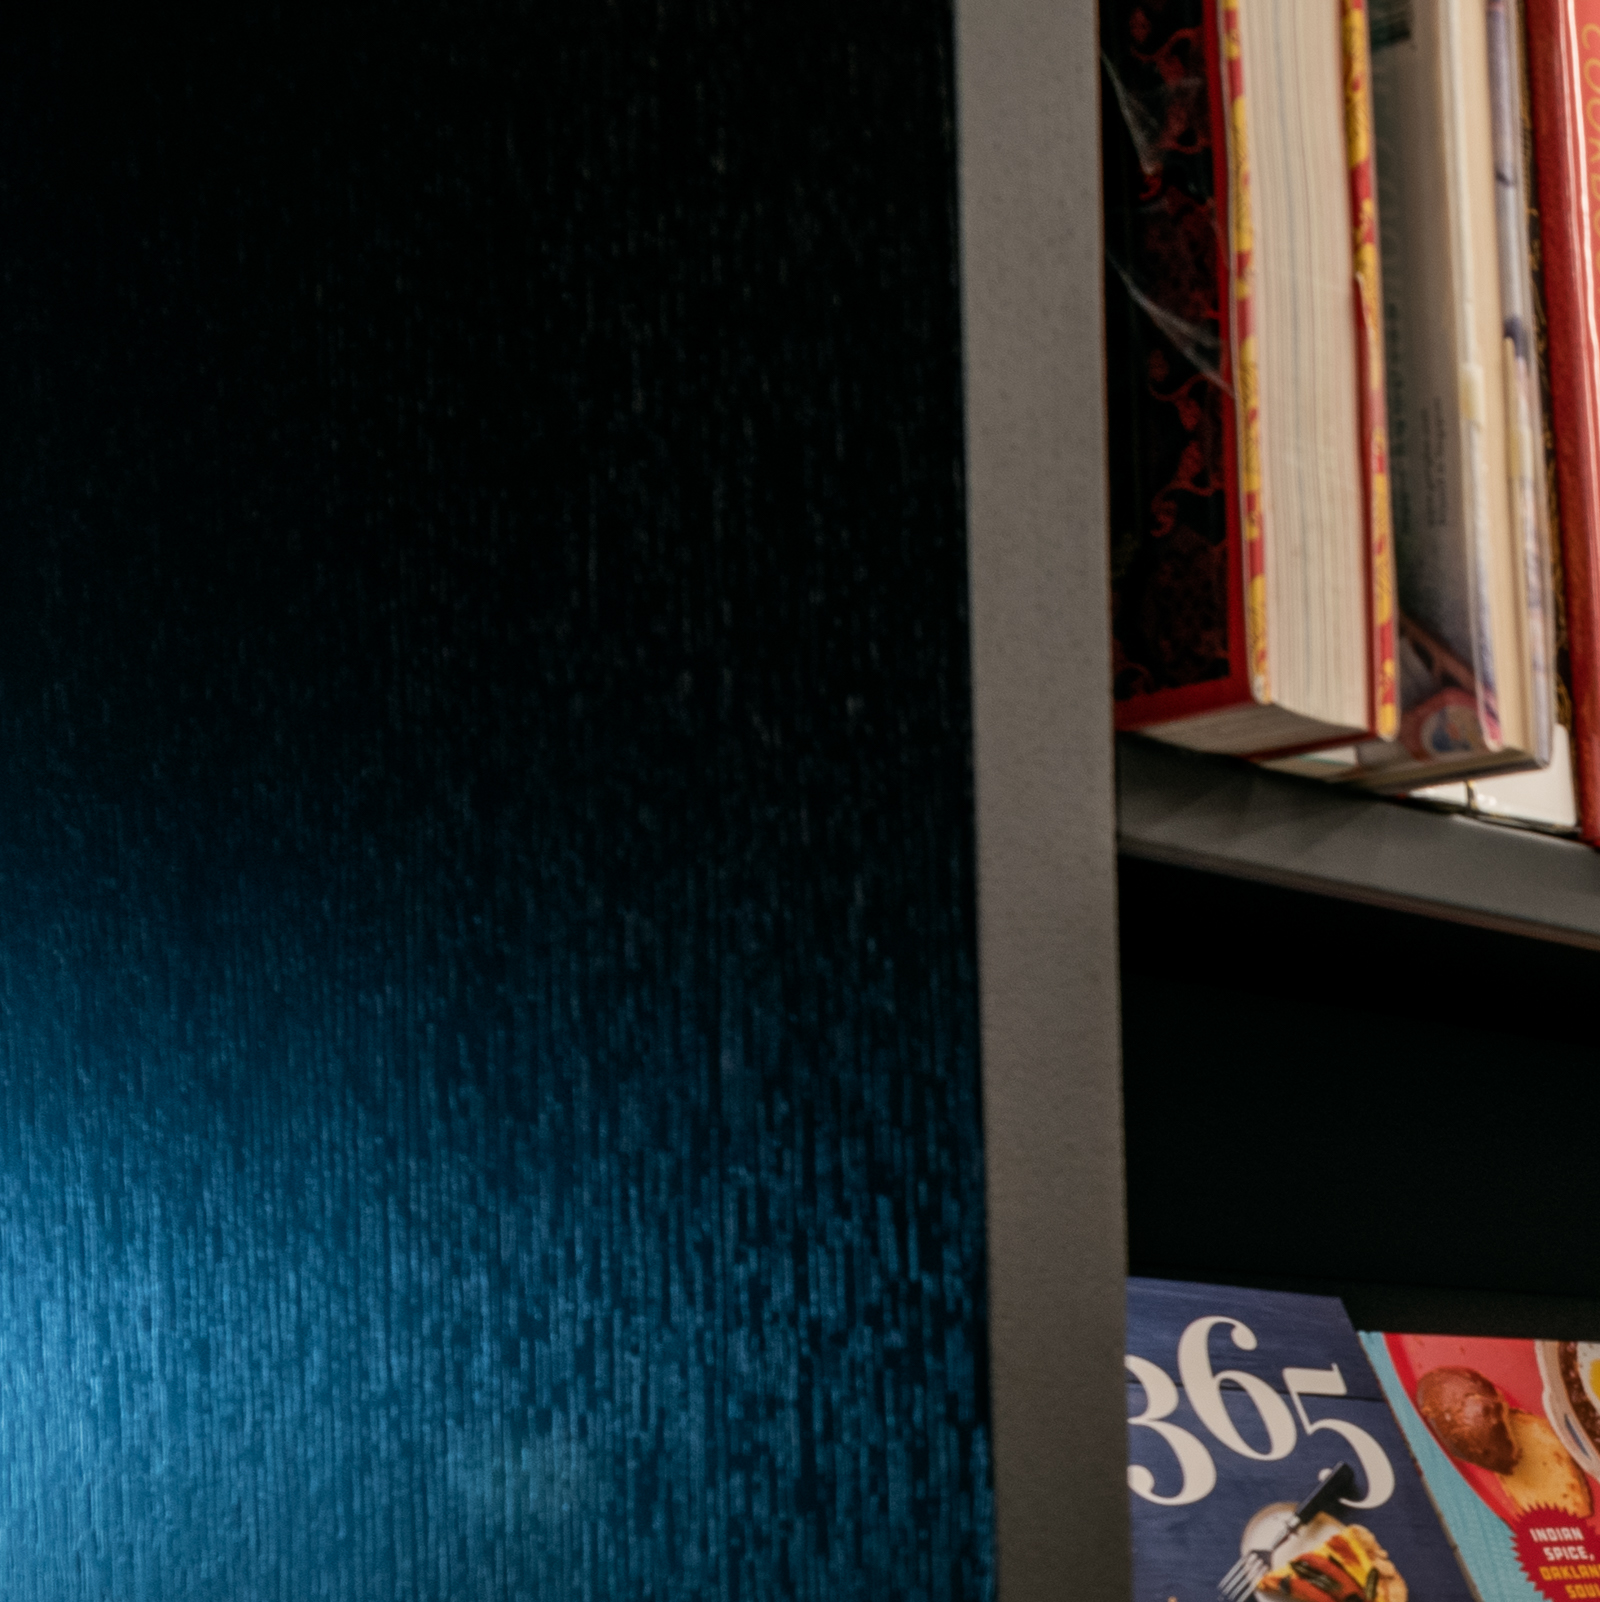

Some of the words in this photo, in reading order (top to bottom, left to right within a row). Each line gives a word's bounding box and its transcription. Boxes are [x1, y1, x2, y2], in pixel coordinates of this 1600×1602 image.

[1125, 1314, 1397, 1511] 365
[1530, 1525, 1584, 1545] INDIAN
[1543, 1544, 1597, 1564] SPICE,
